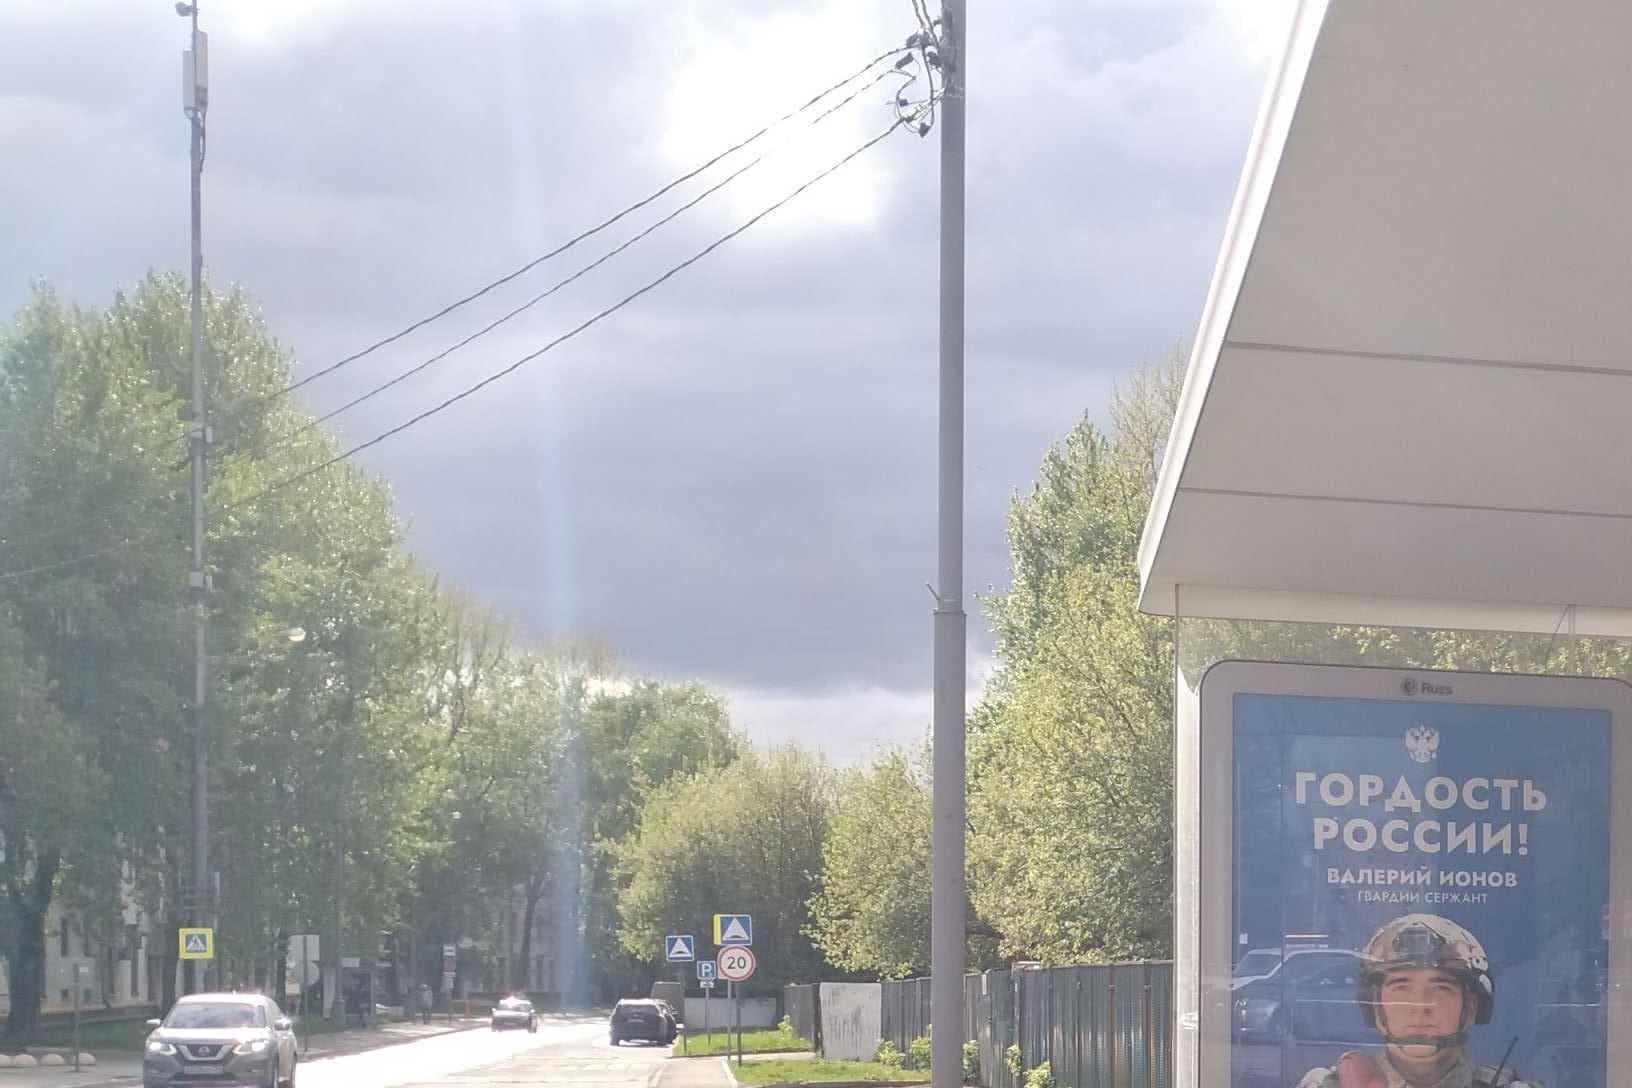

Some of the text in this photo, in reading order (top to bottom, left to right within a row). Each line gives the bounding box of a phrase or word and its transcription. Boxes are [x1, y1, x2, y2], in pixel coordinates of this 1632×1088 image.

[1295, 771, 1547, 812] ГОРДОСТЬ
[1313, 817, 1529, 855] РОССИИ!
[1327, 866, 1518, 888] ВАЛЕРИЙ ИОНОВ
[1358, 890, 1488, 905] ГВАРДИИ СЕРЖАНТ
[727, 956, 746, 969] 20
